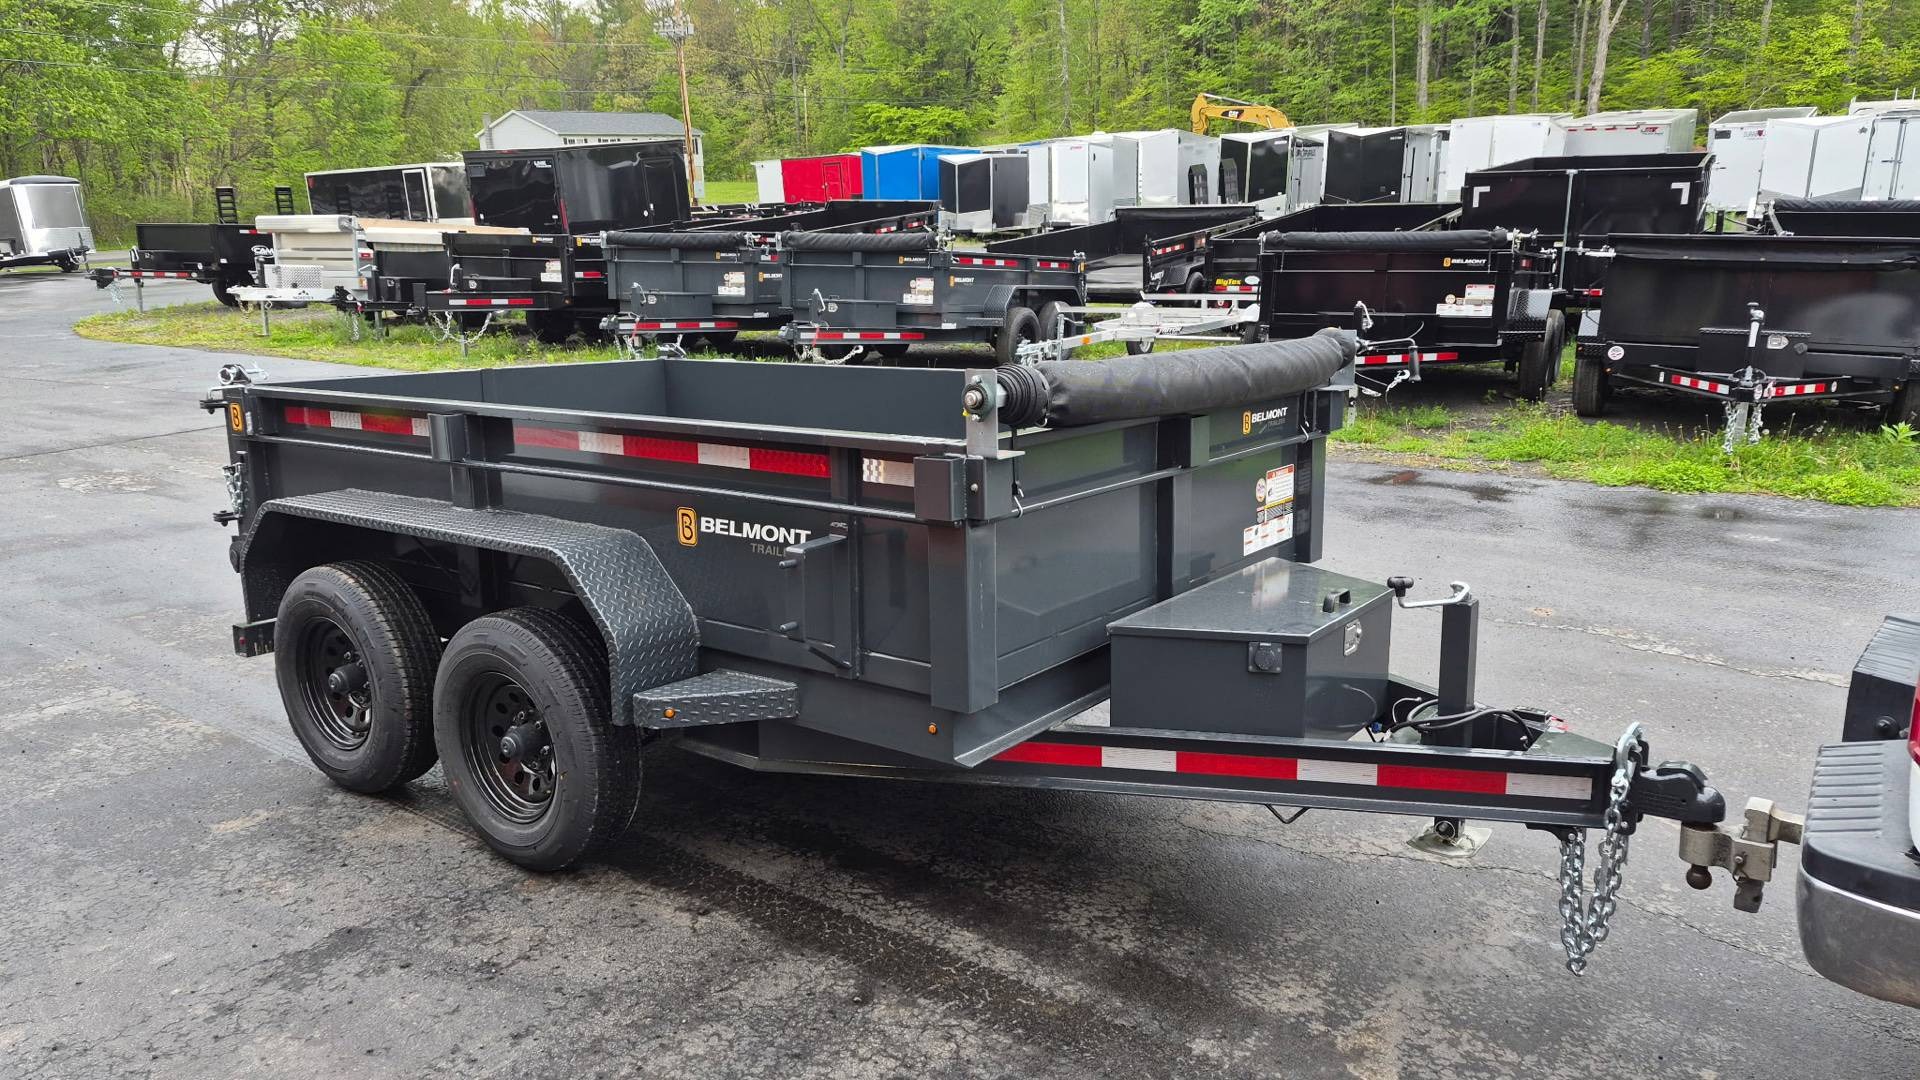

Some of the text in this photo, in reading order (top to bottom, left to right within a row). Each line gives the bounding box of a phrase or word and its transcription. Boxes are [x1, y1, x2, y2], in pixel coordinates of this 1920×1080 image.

[1251, 406, 1288, 424] BELMONT
[700, 516, 812, 545] BELMONT
[750, 542, 786, 557] TRAIL
